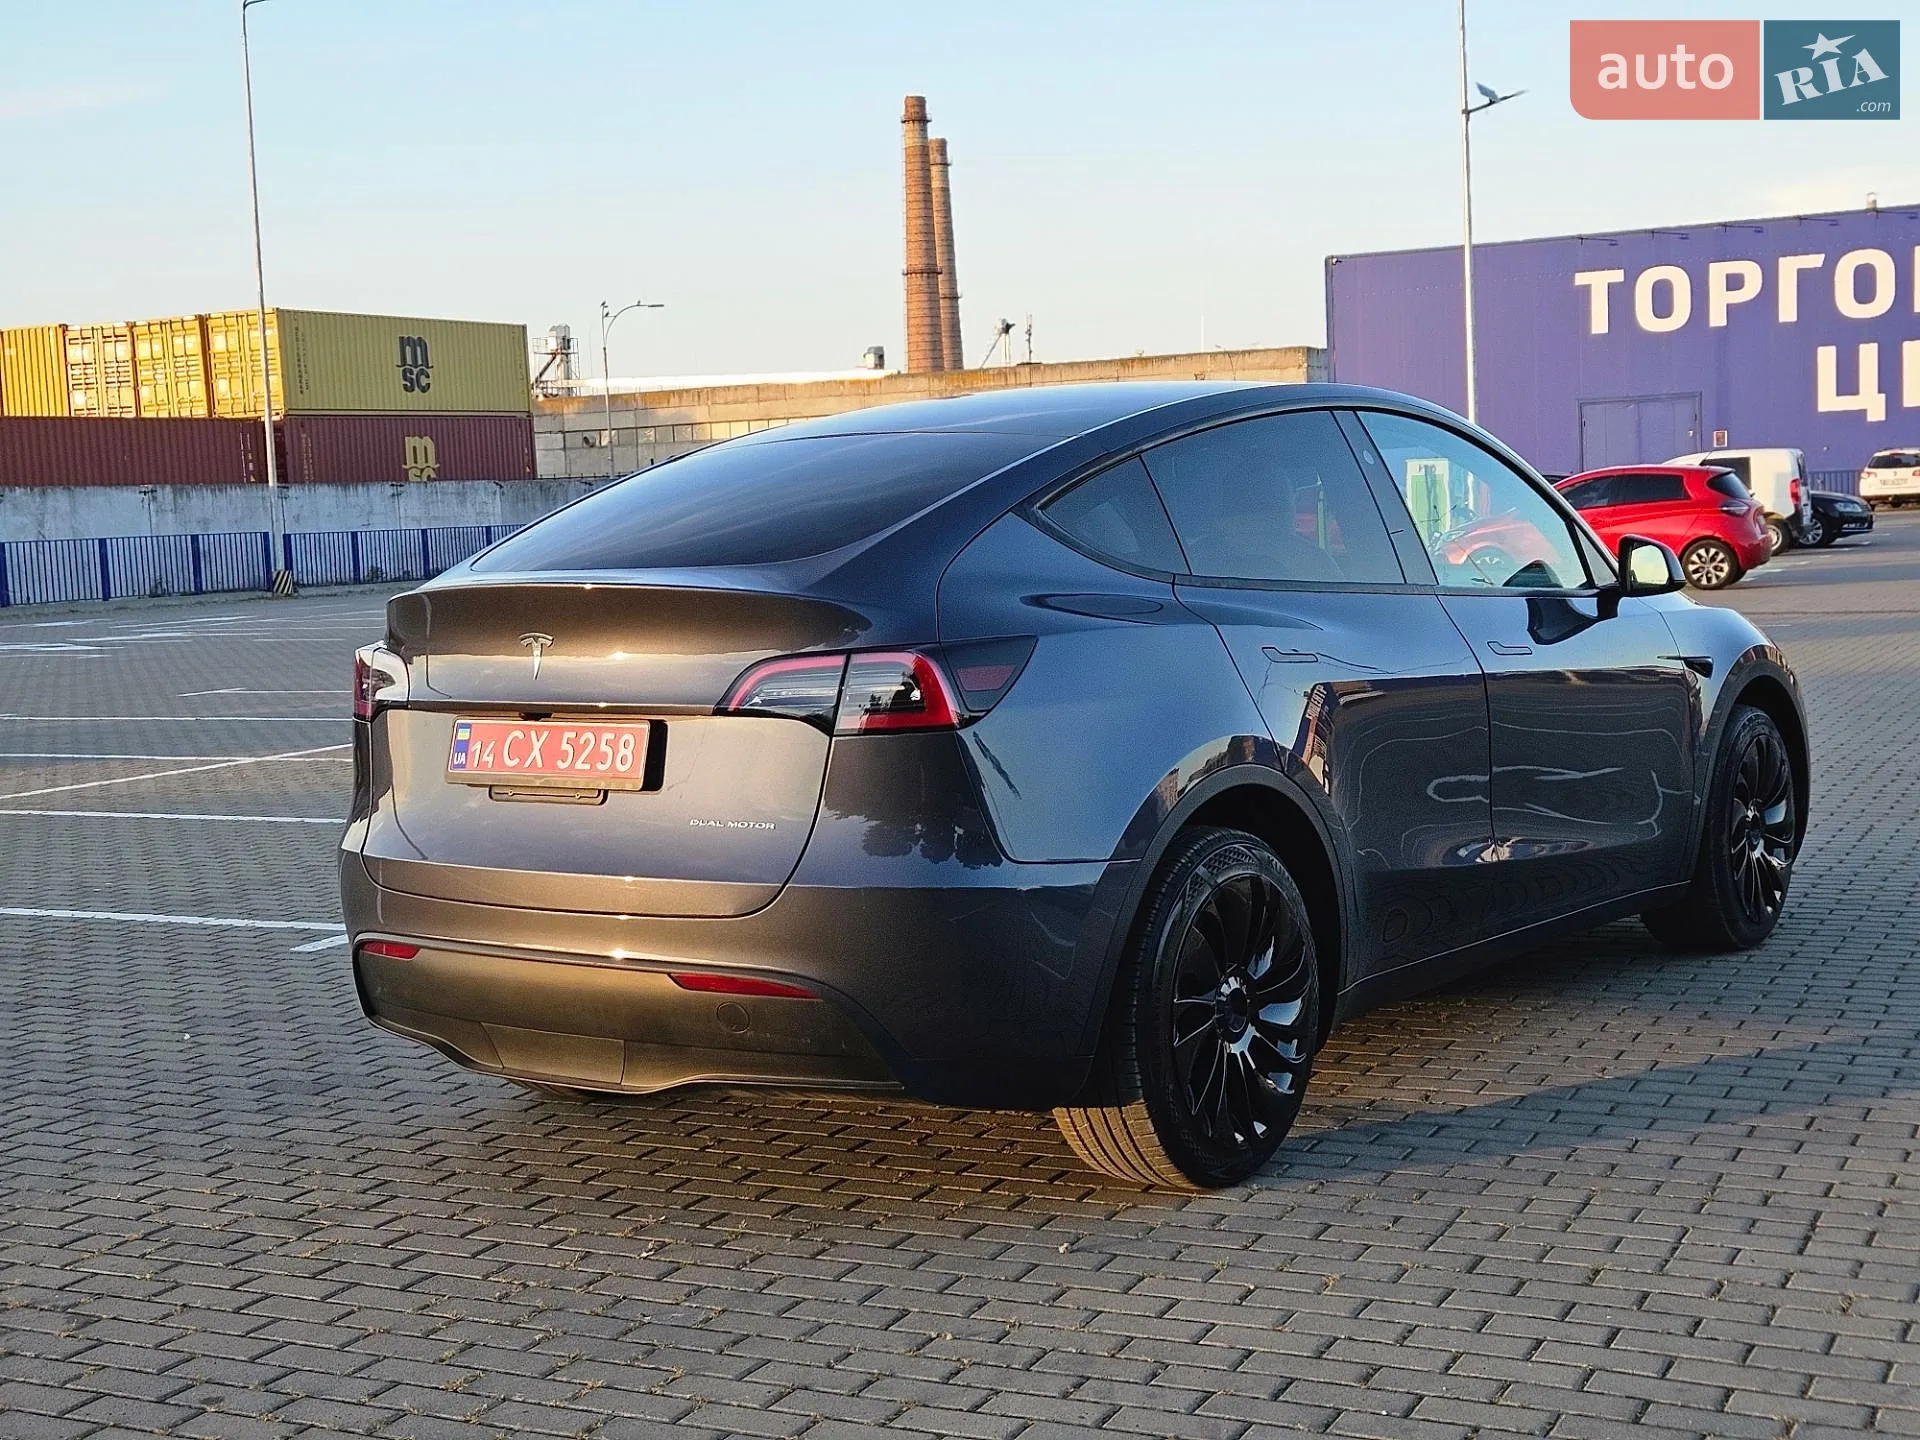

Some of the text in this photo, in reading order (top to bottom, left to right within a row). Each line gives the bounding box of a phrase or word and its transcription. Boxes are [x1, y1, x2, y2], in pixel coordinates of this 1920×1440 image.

[1574, 245, 1920, 335] ТОРГО
[453, 751, 466, 765] UA
[471, 729, 636, 773] 14 CX 5258
[690, 819, 776, 830] DUAL MOTOR
